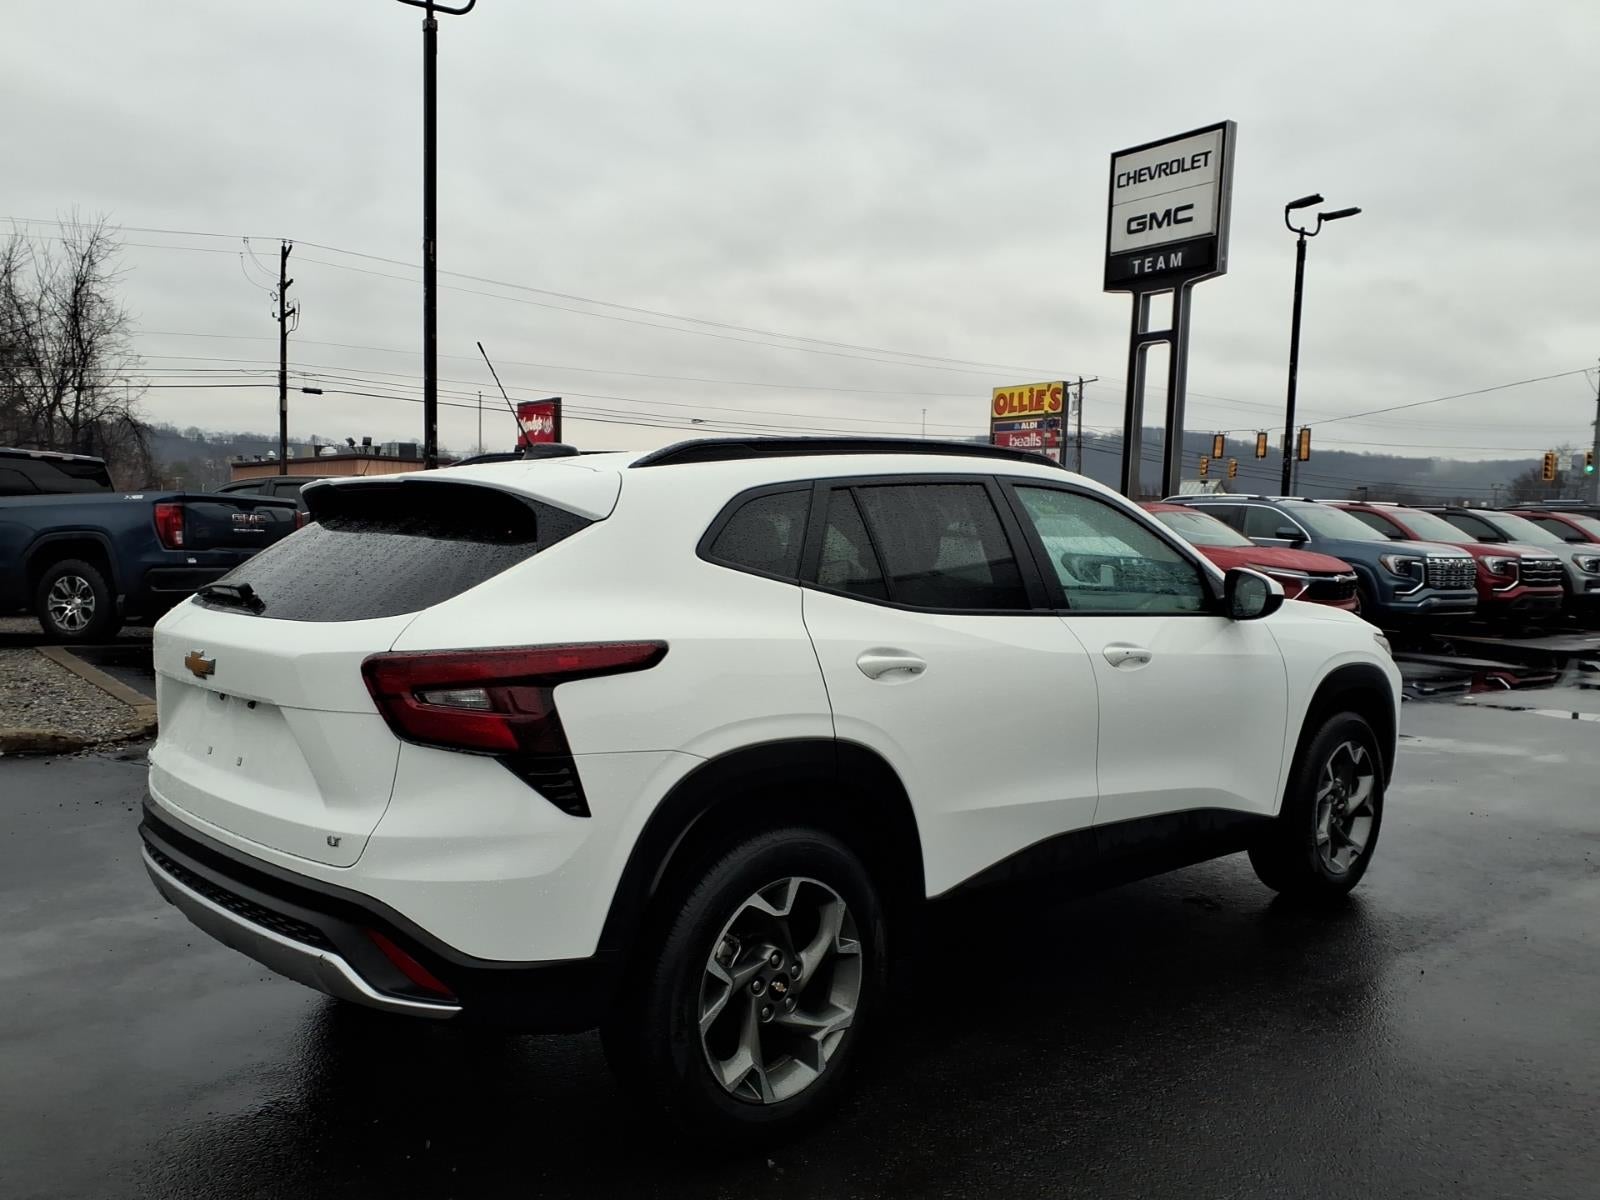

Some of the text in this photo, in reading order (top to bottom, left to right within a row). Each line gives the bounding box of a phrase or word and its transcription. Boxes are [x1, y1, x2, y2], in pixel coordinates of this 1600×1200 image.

[1117, 151, 1212, 188] CHEVROLET
[1127, 203, 1194, 235] GMC
[1133, 252, 1182, 274] TEAM
[1021, 421, 1037, 430] ALDI
[1009, 432, 1042, 447] bealls
